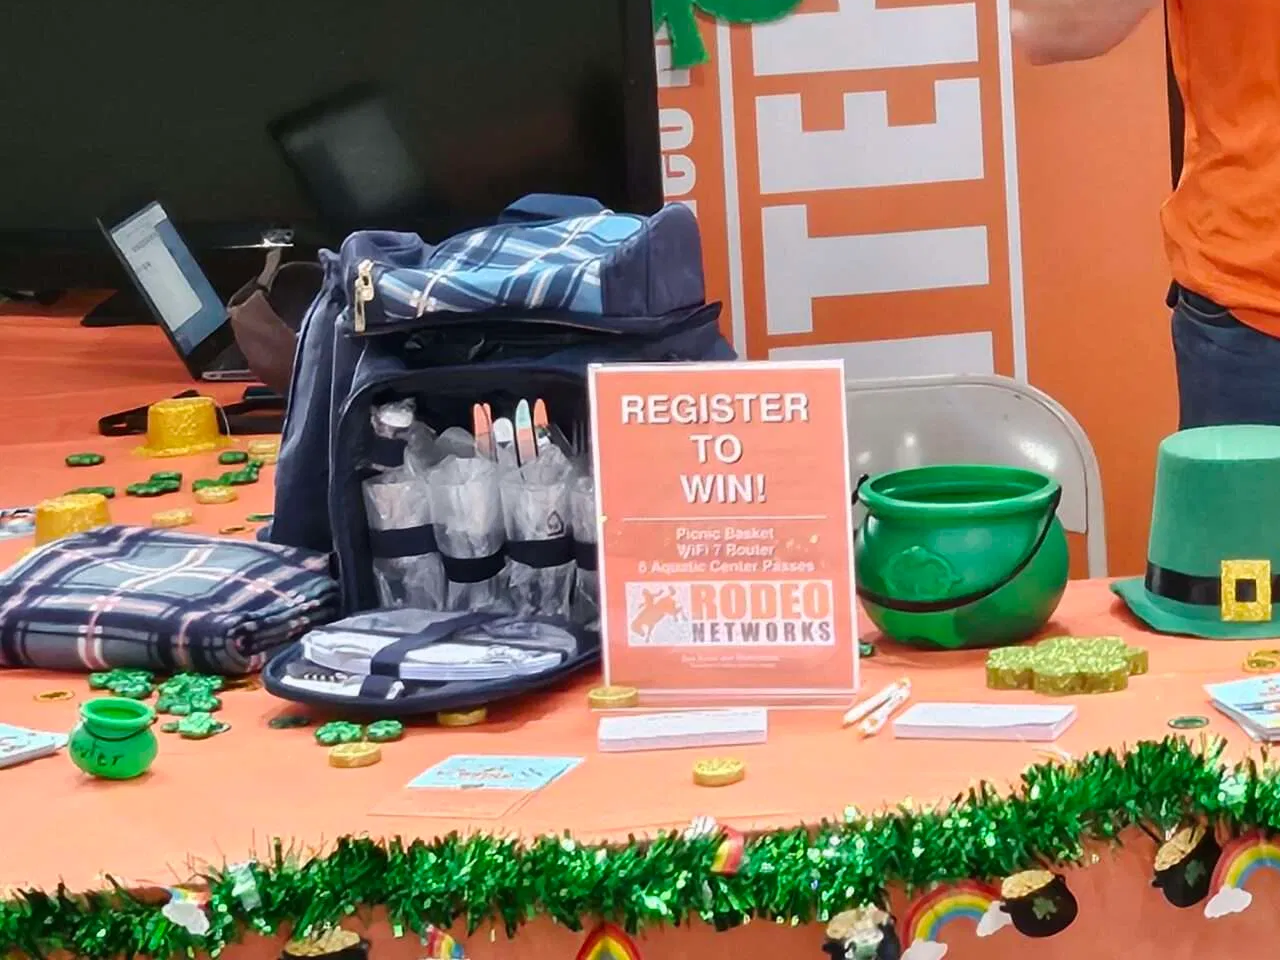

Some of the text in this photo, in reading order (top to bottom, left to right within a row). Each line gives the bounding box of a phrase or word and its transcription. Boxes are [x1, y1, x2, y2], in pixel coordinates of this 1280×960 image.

[620, 393, 810, 425] REGISTER
[689, 433, 743, 464] TO
[680, 473, 768, 504] WIN!
[676, 526, 774, 541] Picnic Basket
[713, 543, 722, 557] 7
[726, 543, 776, 557] Router
[710, 559, 757, 573] Center
[762, 559, 815, 573] Passes
[690, 583, 830, 620] RODEO
[692, 621, 831, 643] NETWORKS
